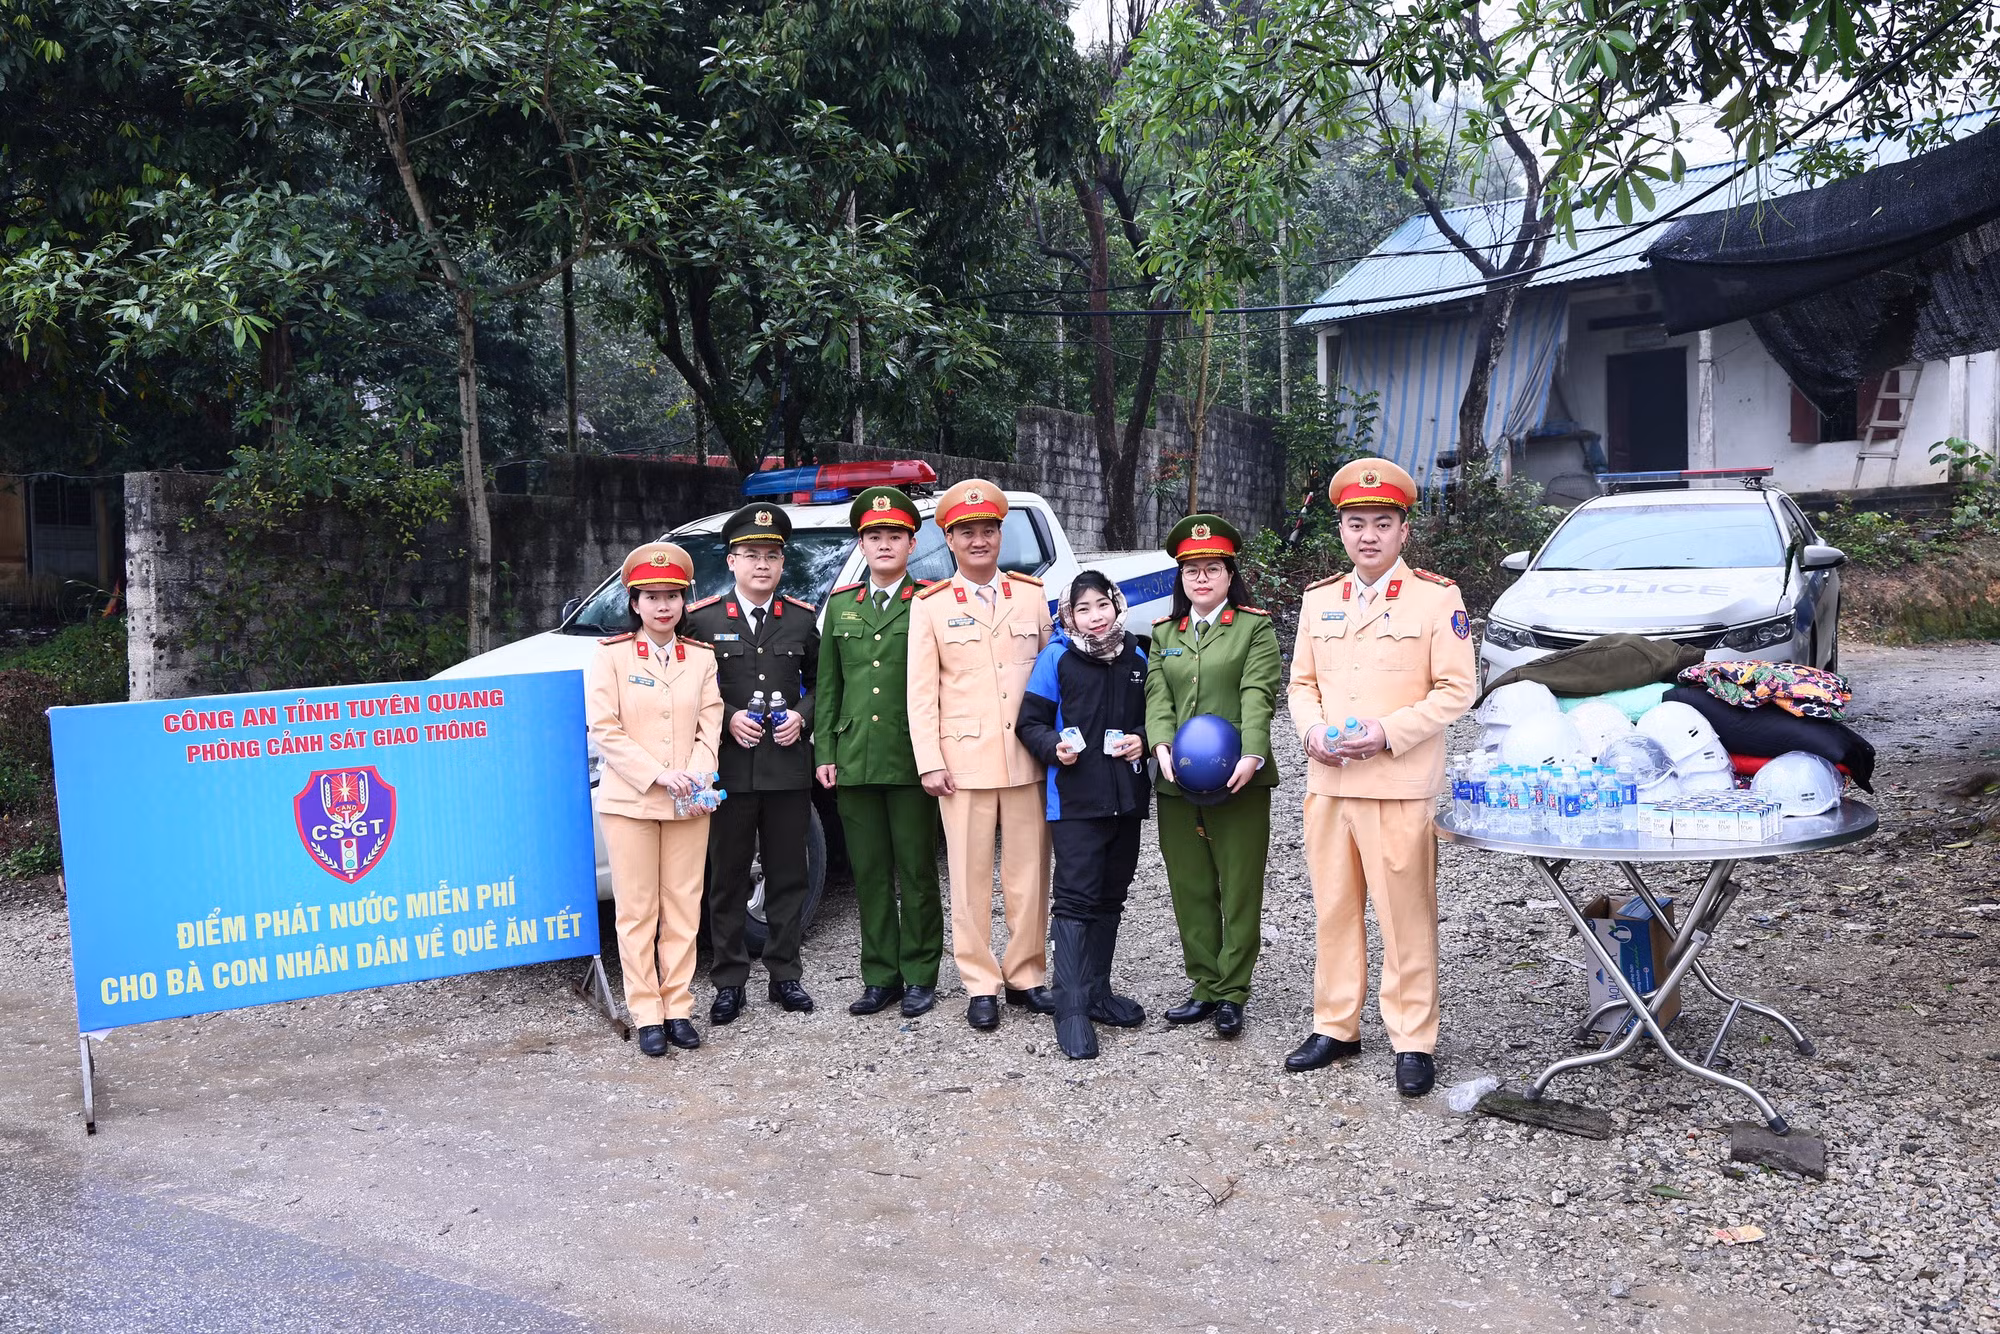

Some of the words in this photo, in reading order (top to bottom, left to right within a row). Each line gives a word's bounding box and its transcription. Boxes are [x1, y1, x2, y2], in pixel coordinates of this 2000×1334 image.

[1545, 584, 1731, 598] POLICE
[163, 709, 234, 733] CÔNG
[242, 706, 277, 727] AN
[284, 698, 340, 723] TỈNH
[347, 693, 420, 718] TUYÊN
[427, 689, 504, 713] QUANG
[187, 738, 259, 763] PHÒNG
[266, 730, 323, 756] CẢNH
[330, 728, 366, 751] SÁT
[373, 726, 418, 747] GIAO
[424, 720, 488, 742] THÔNG
[176, 907, 247, 950] ĐIỂM
[255, 902, 322, 940] PHÁT
[329, 890, 399, 929] NƯỚC
[406, 879, 470, 919] MIỄN
[476, 875, 516, 910] PHÍ
[100, 972, 157, 1005] CHO
[167, 960, 205, 996] BÀ
[212, 956, 268, 990] CON
[276, 942, 349, 981] NHÂN
[356, 935, 408, 969] DÂN
[414, 923, 445, 960] VỀ
[452, 919, 498, 957] QUÊ
[505, 916, 538, 947] ĂN
[544, 905, 582, 941] TẾT
